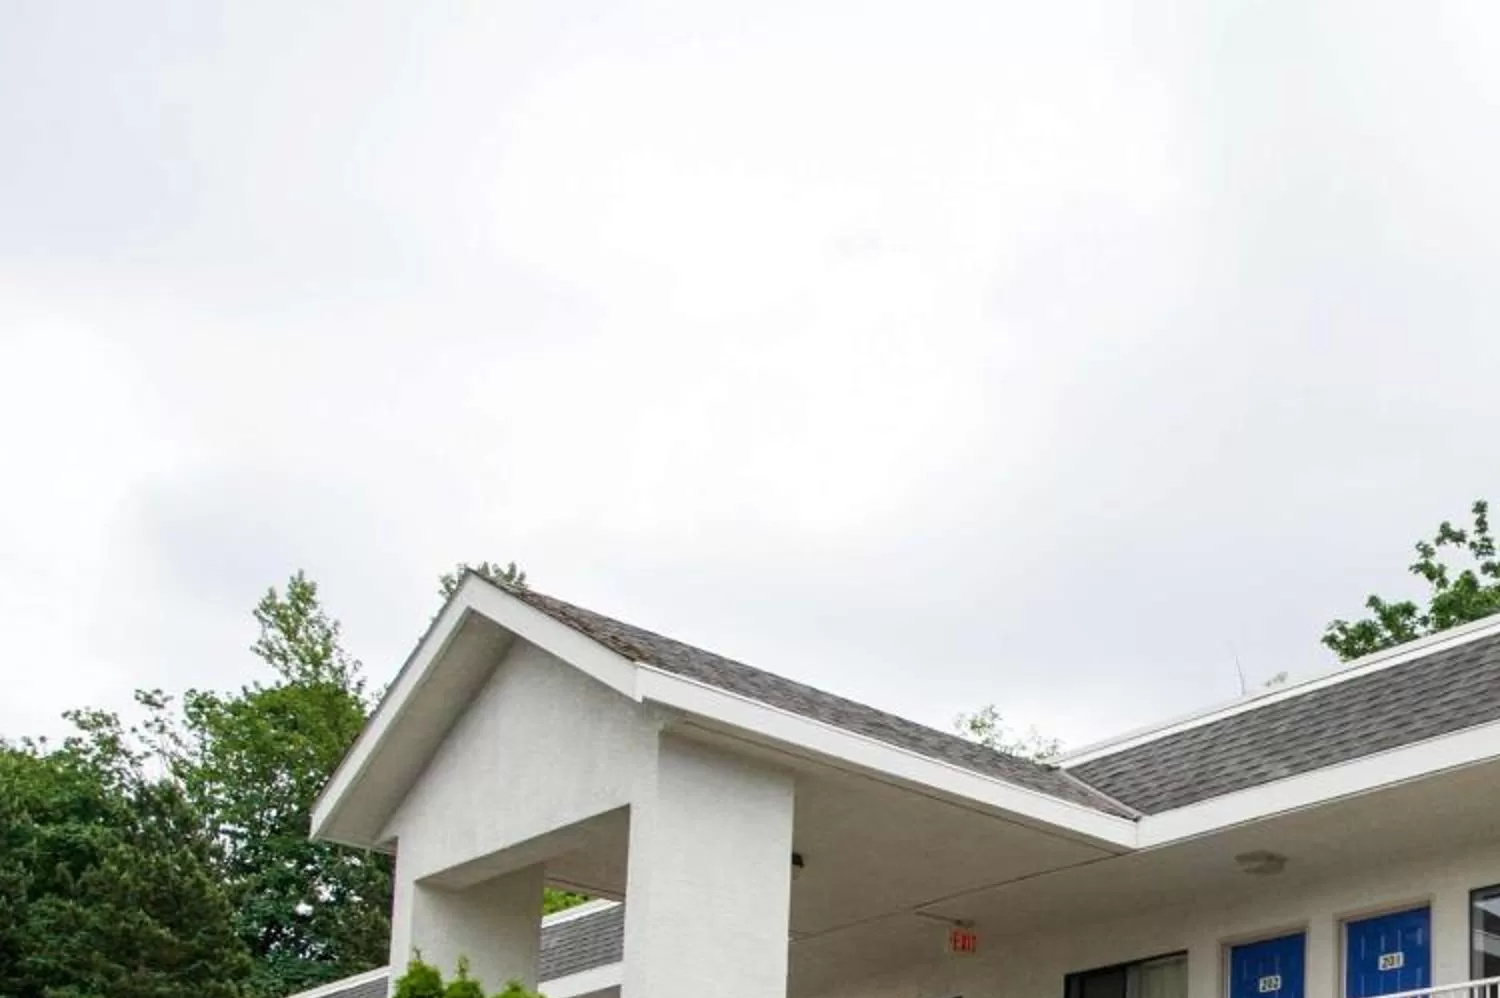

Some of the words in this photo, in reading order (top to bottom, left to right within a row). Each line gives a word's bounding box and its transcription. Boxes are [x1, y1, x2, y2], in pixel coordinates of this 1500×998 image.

[953, 931, 977, 952] EXIT
[1382, 954, 1402, 970] 201
[1261, 976, 1279, 991] 202
